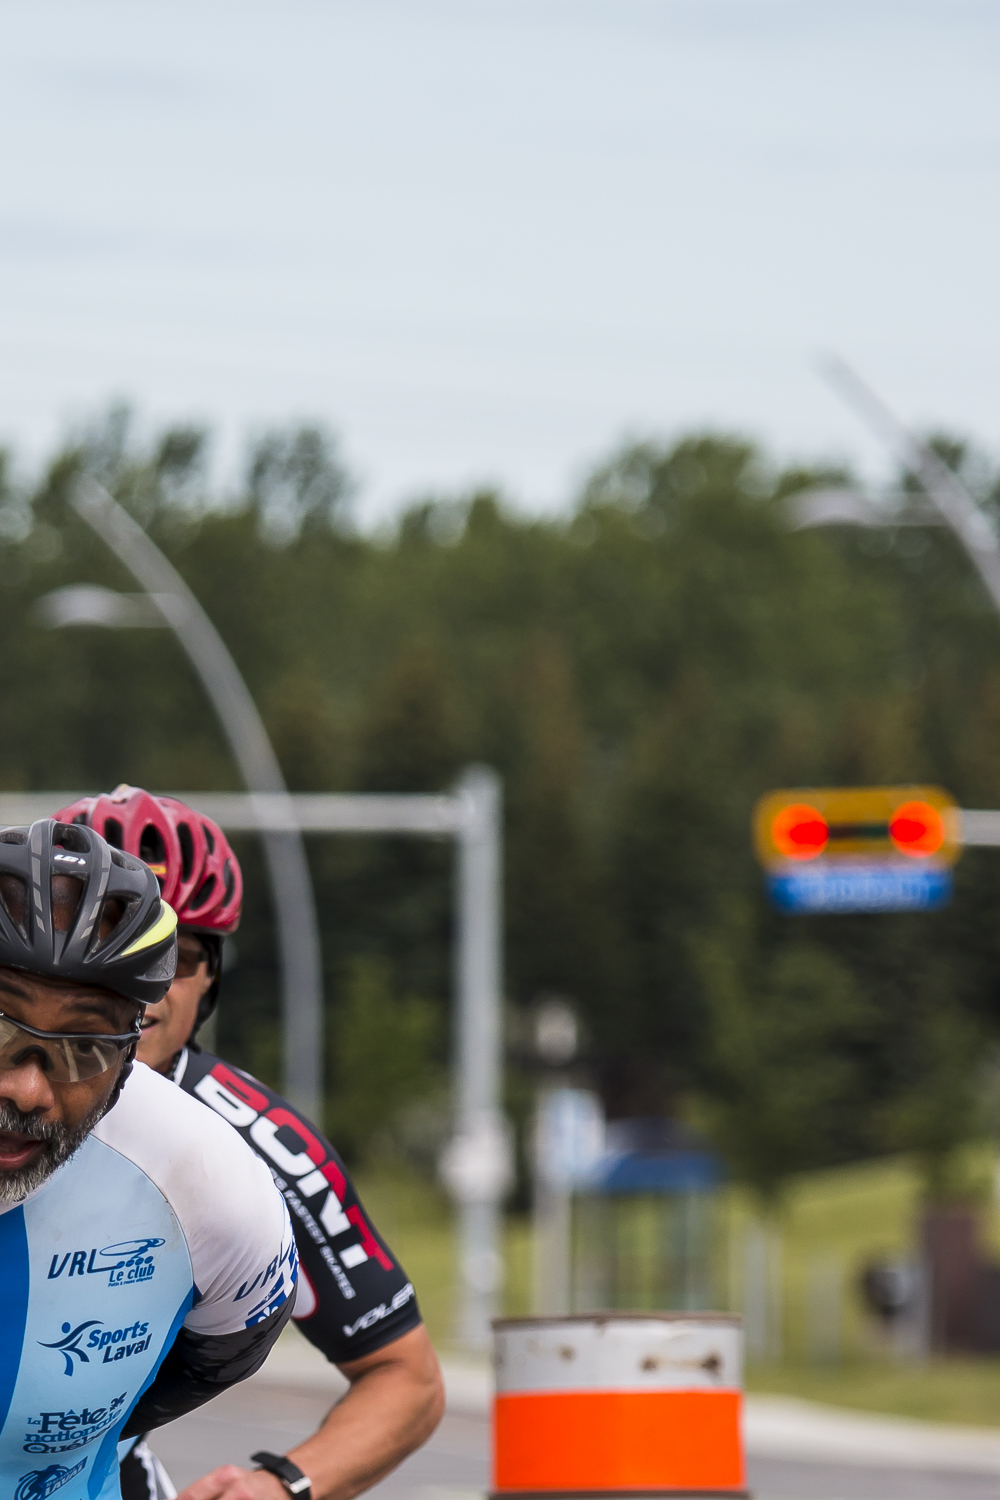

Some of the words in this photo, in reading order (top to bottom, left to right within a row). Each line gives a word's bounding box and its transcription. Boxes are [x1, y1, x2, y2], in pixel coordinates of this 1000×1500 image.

[194, 1063, 394, 1272] BONT
[47, 1248, 120, 1280] VRL
[109, 1269, 124, 1283] Le
[127, 1263, 156, 1280] club
[86, 1320, 150, 1351] Sports
[102, 1332, 153, 1364] Laval
[24, 1408, 123, 1443] nationale
[27, 1417, 42, 1426] La
[37, 1407, 107, 1434] Fête
